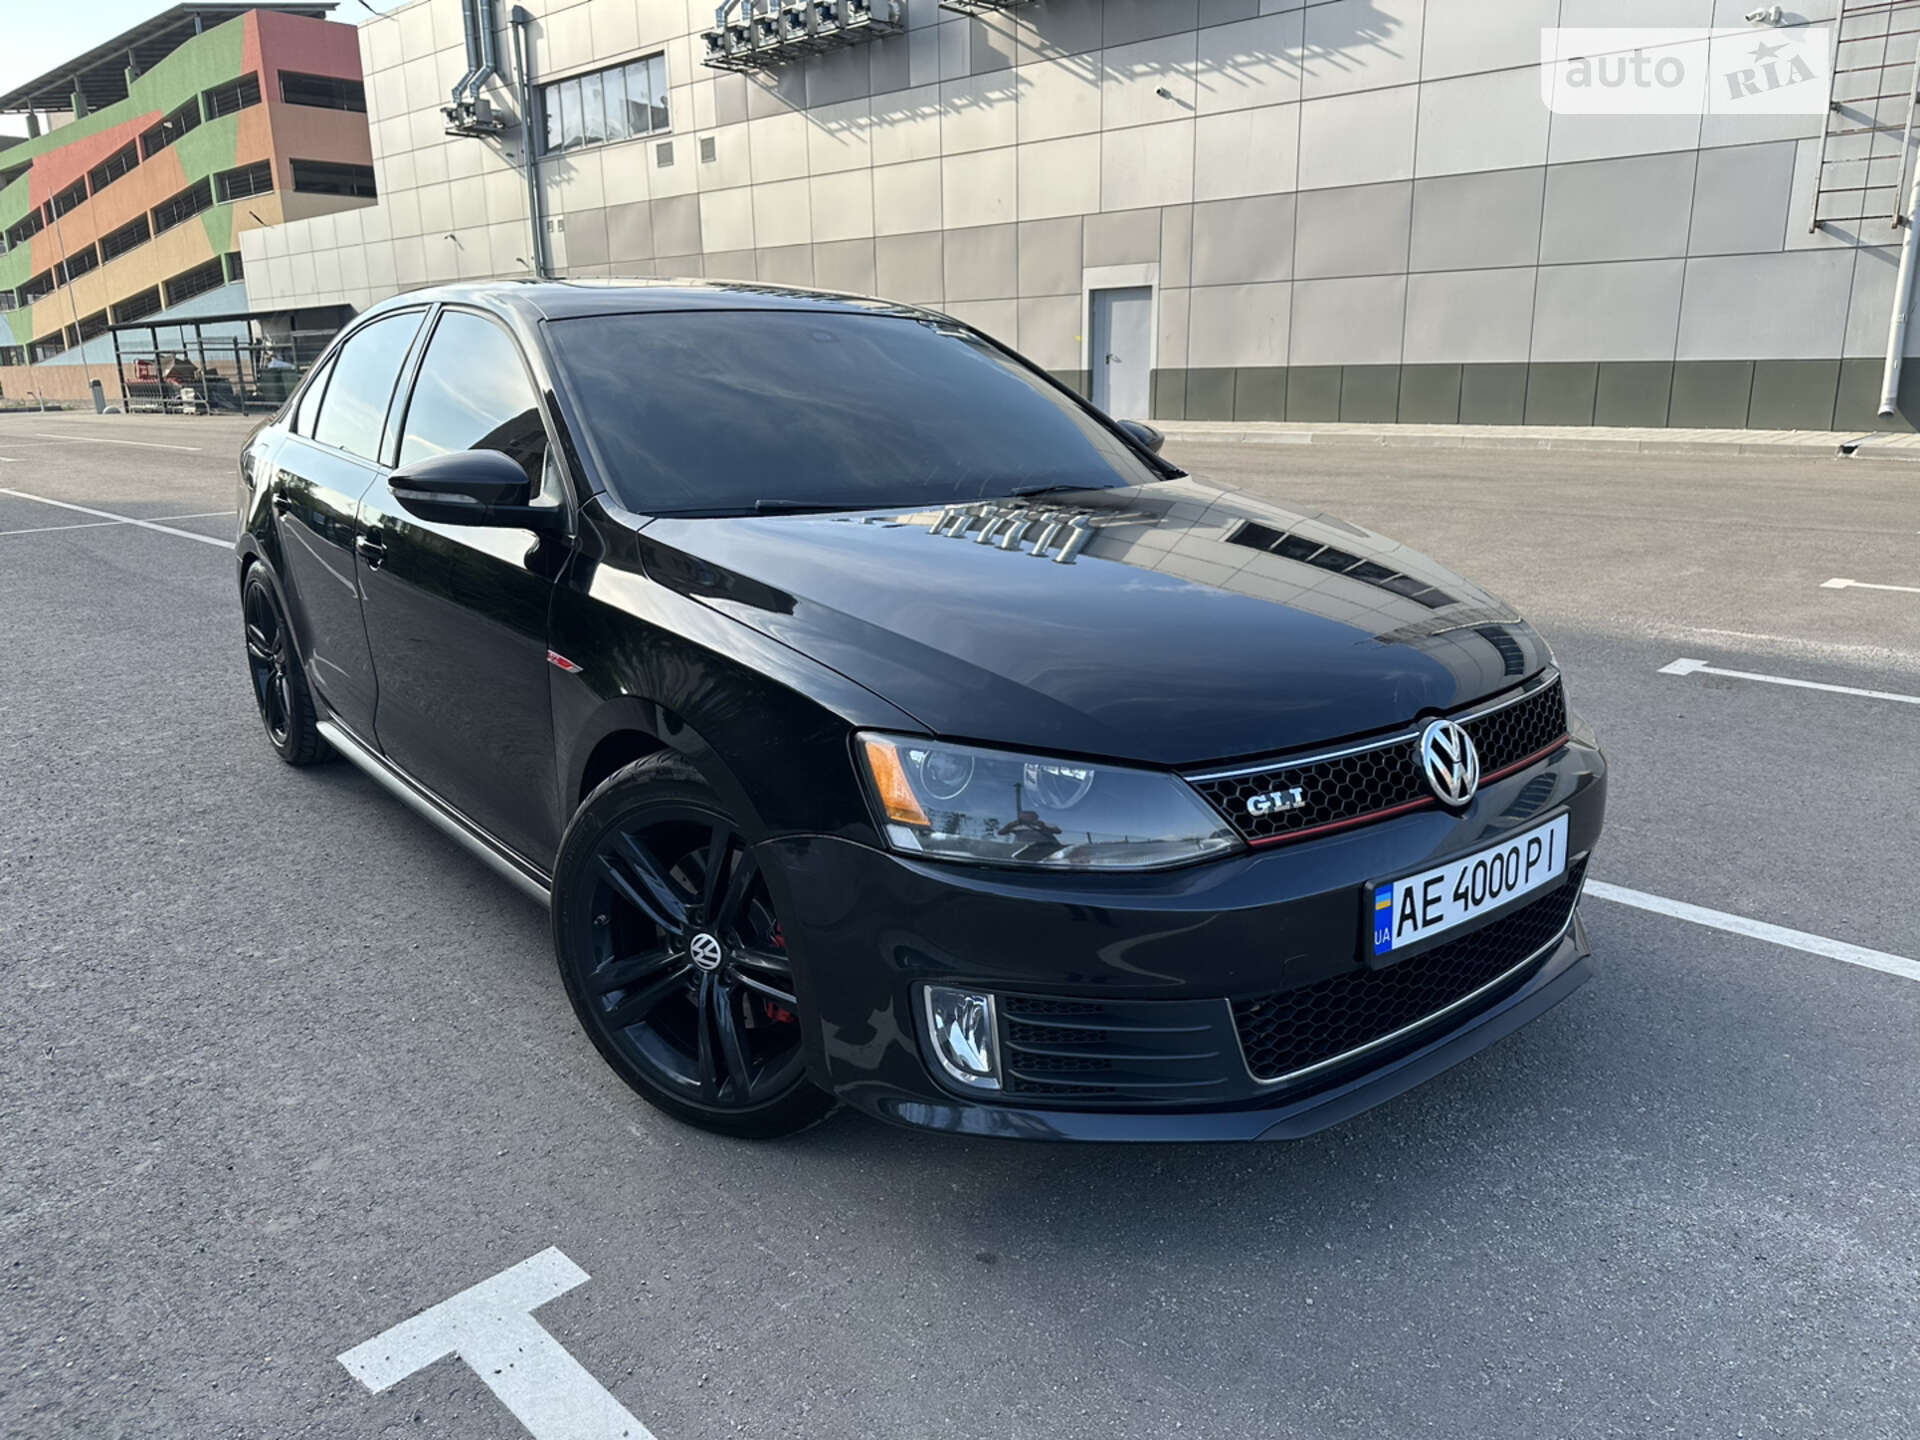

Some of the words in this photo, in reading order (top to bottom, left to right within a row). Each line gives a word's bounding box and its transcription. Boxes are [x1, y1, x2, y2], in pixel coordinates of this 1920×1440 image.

[1421, 719, 1479, 807] VW
[1246, 788, 1305, 816] GLI
[1375, 928, 1391, 945] UA
